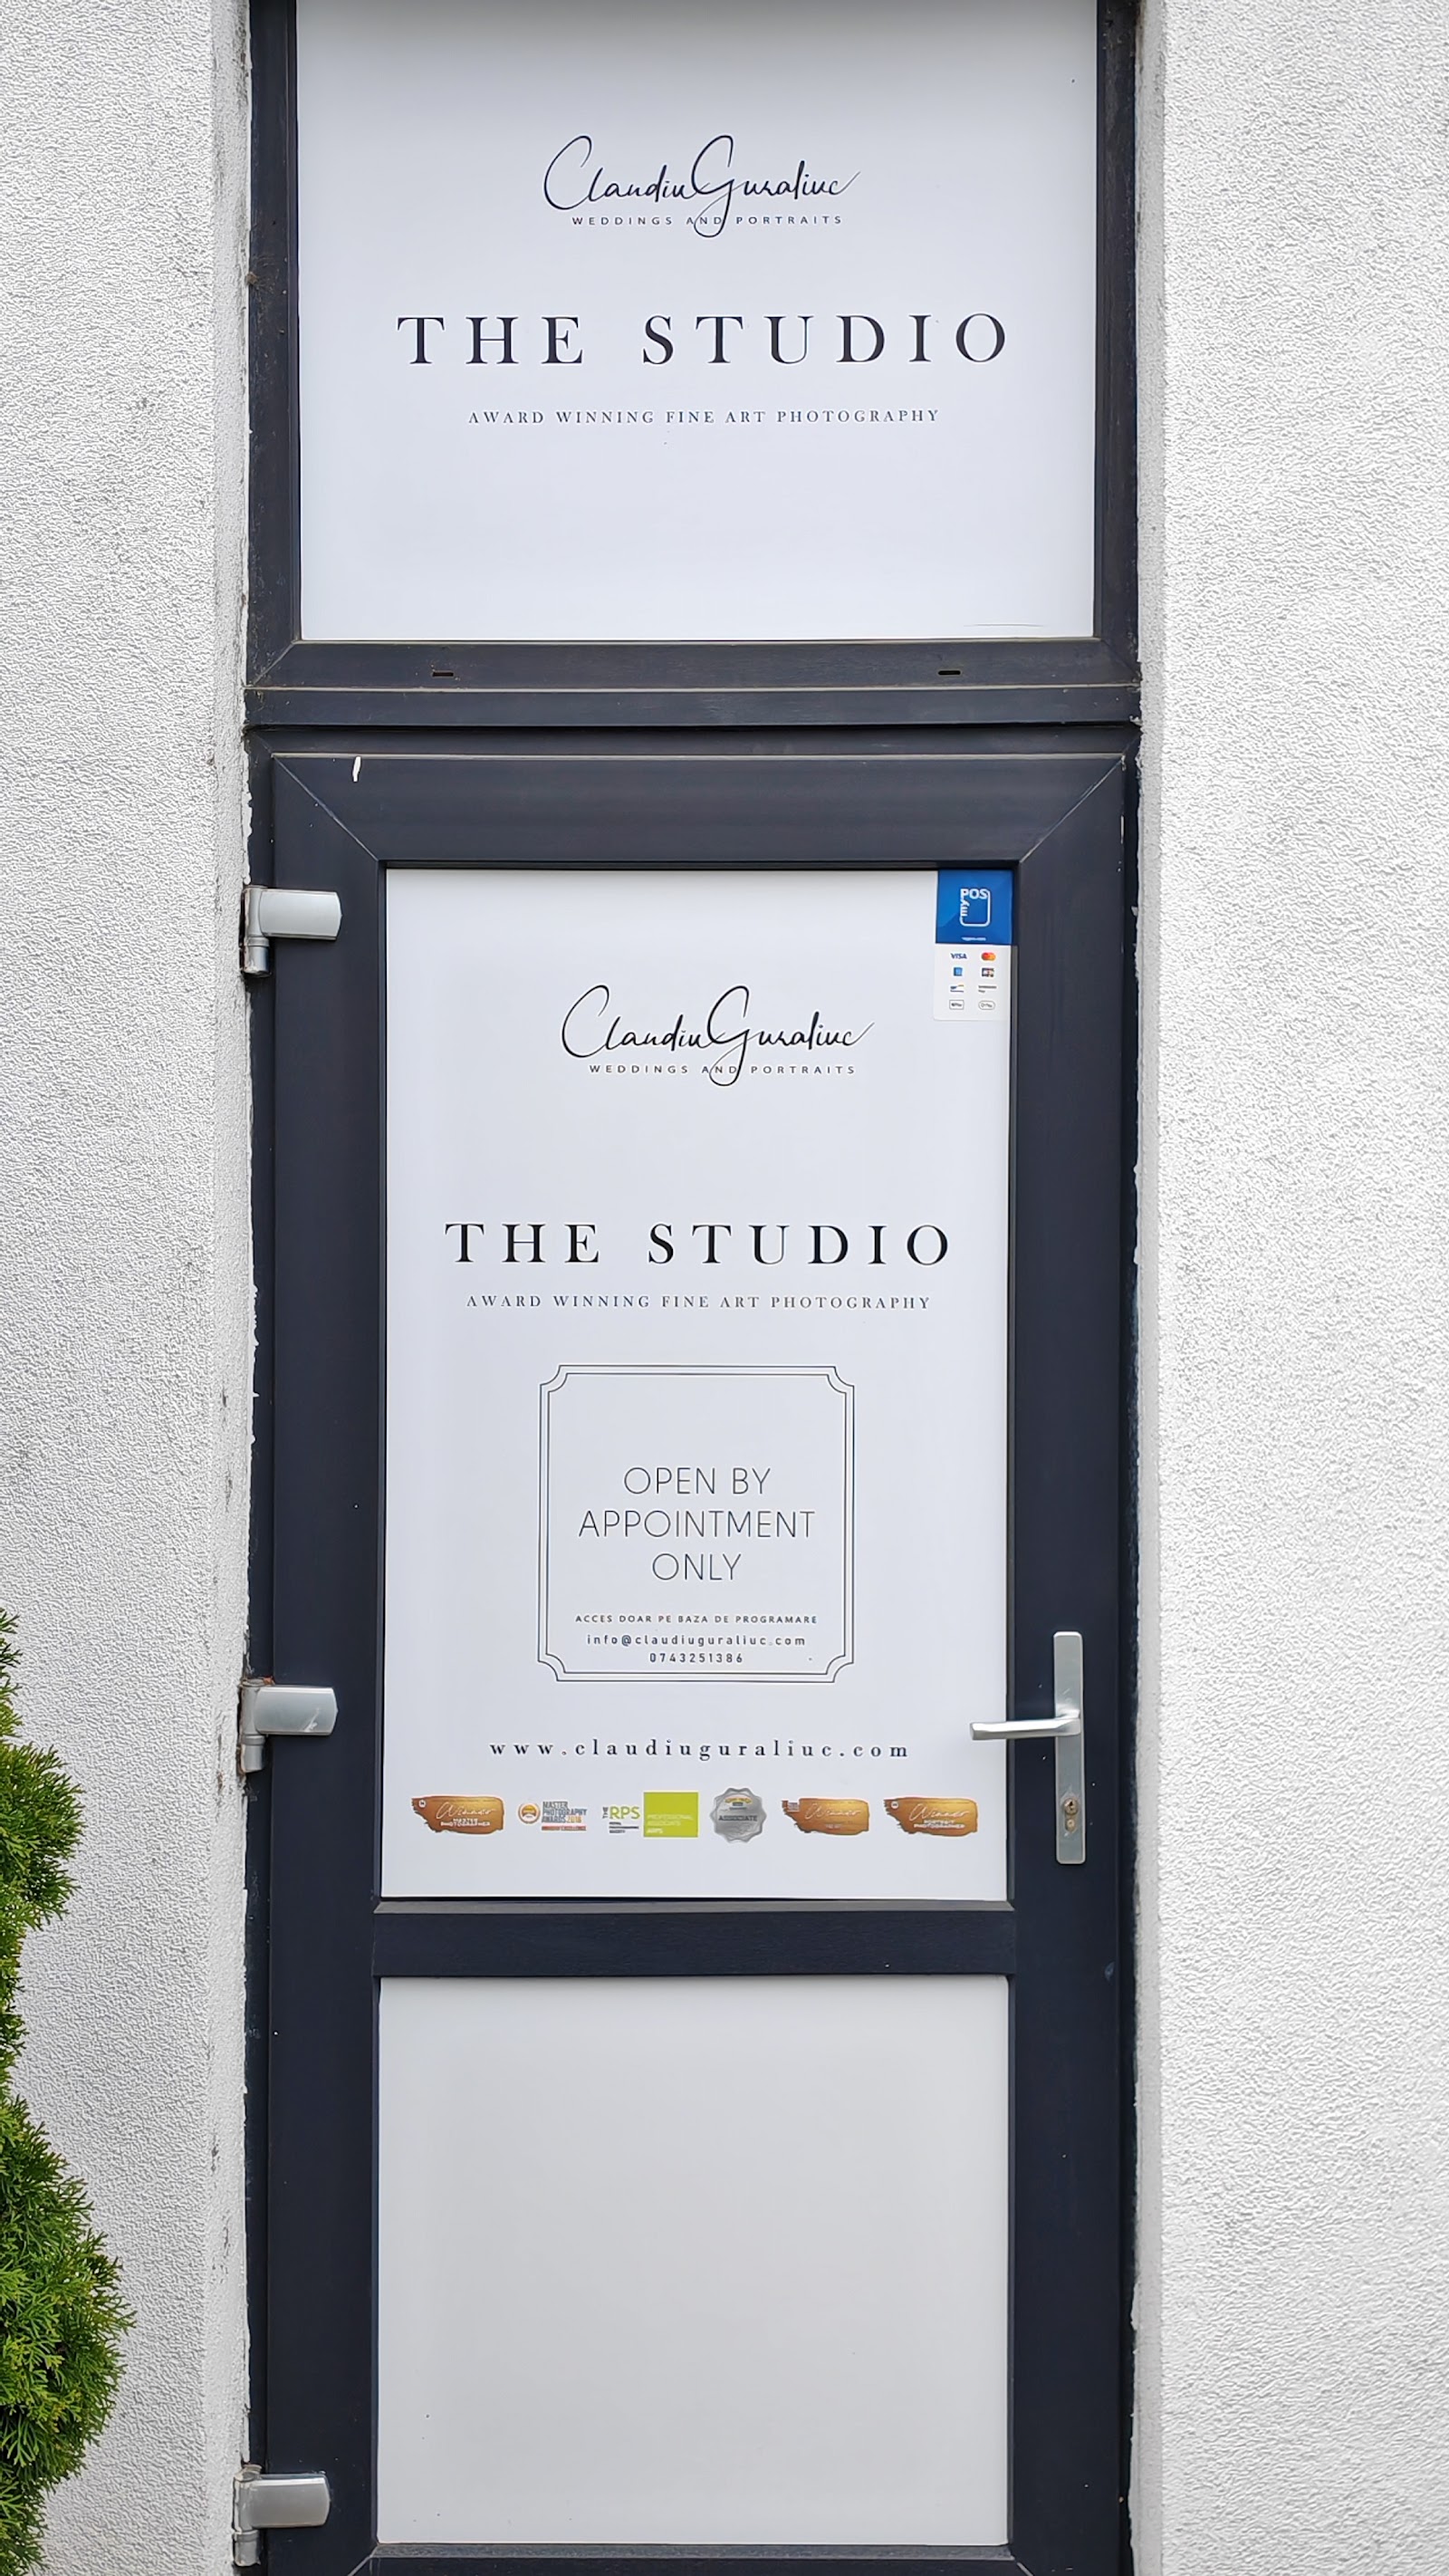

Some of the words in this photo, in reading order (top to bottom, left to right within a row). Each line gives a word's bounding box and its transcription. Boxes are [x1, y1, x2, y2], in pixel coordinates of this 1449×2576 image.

[572, 216, 673, 226] WEDDINGS
[686, 216, 723, 226] AND
[735, 216, 841, 225] PORTRAITS
[398, 316, 583, 365] THE
[642, 313, 1006, 365] STUDIO
[468, 410, 544, 424] AWARD
[555, 410, 654, 424] WINNING
[666, 410, 715, 424] FINE
[724, 410, 766, 423] ART
[776, 409, 939, 423] PHOTOGRAPHY
[589, 1064, 688, 1074] WEDDINGS
[701, 1065, 738, 1074] AND
[751, 1065, 855, 1075] PORTRAITS
[445, 1223, 600, 1264] THE
[648, 1223, 949, 1266] STUDIO
[466, 1294, 542, 1307] AWARD
[552, 1295, 649, 1308] WINNING
[662, 1295, 709, 1308] FINE
[719, 1296, 760, 1308] ART
[771, 1296, 930, 1310] PHOTOGRAPHY
[624, 1466, 715, 1495] OPEN
[732, 1467, 771, 1495] BY
[578, 1510, 816, 1538] APPOINTMENT
[652, 1552, 742, 1581] ONLY
[575, 1614, 613, 1624] ACCES
[619, 1614, 652, 1624] DOAR
[657, 1614, 672, 1624] PE
[677, 1615, 708, 1624] BAZA
[714, 1615, 729, 1624] DE
[734, 1615, 817, 1625] PROGRAMARE
[587, 1634, 805, 1648] info@claudiuguraliuc.com
[649, 1652, 744, 1664] 0743251386
[489, 1739, 908, 1762] www.claudiuguraliuc.com
[609, 1806, 640, 1819] RPS
